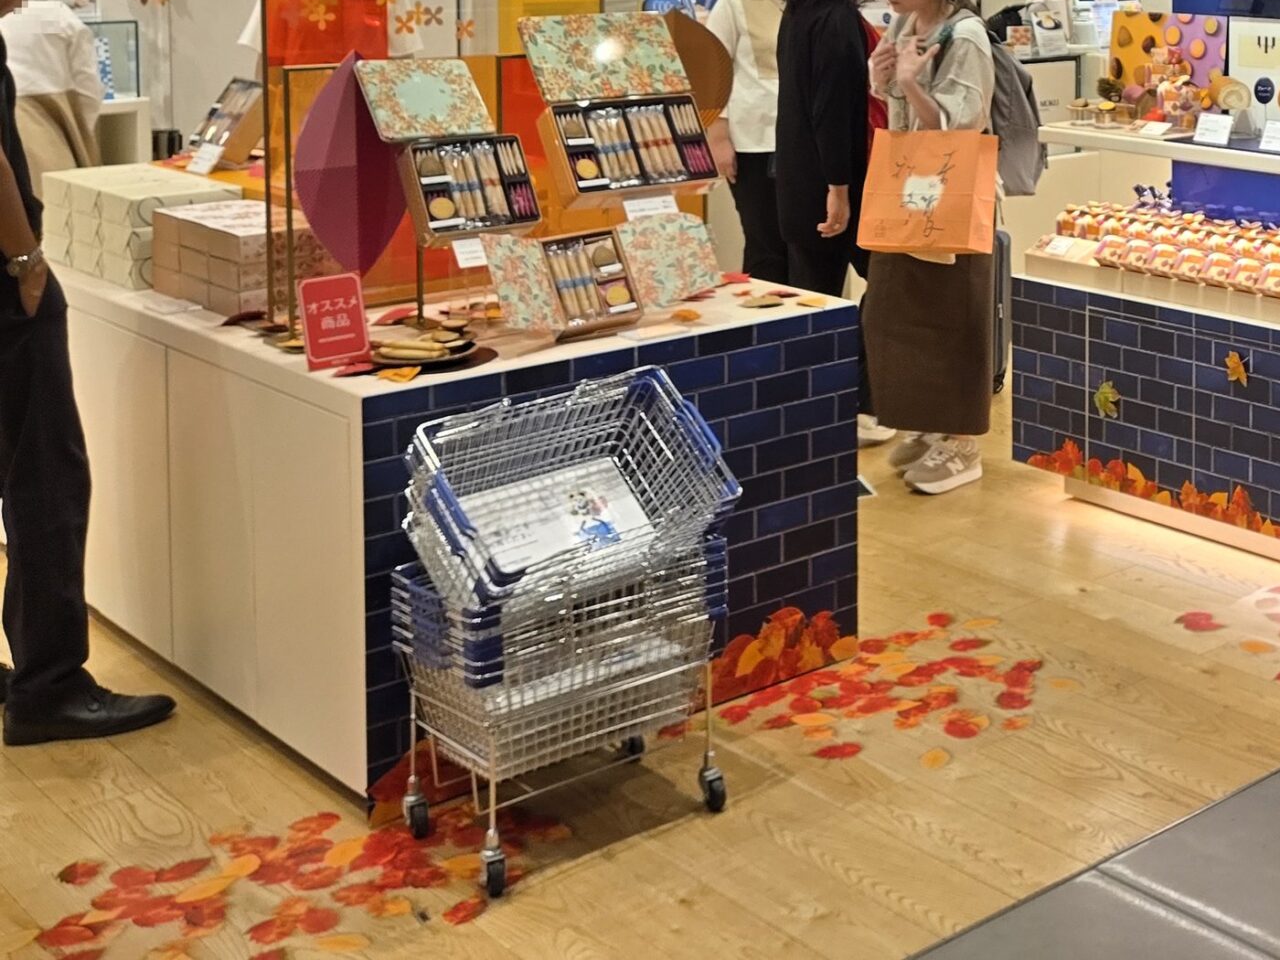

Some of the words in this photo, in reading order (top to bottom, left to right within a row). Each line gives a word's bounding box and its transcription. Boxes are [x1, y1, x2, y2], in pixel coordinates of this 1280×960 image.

[306, 295, 358, 315] オススメ
[321, 313, 351, 330] 商品
